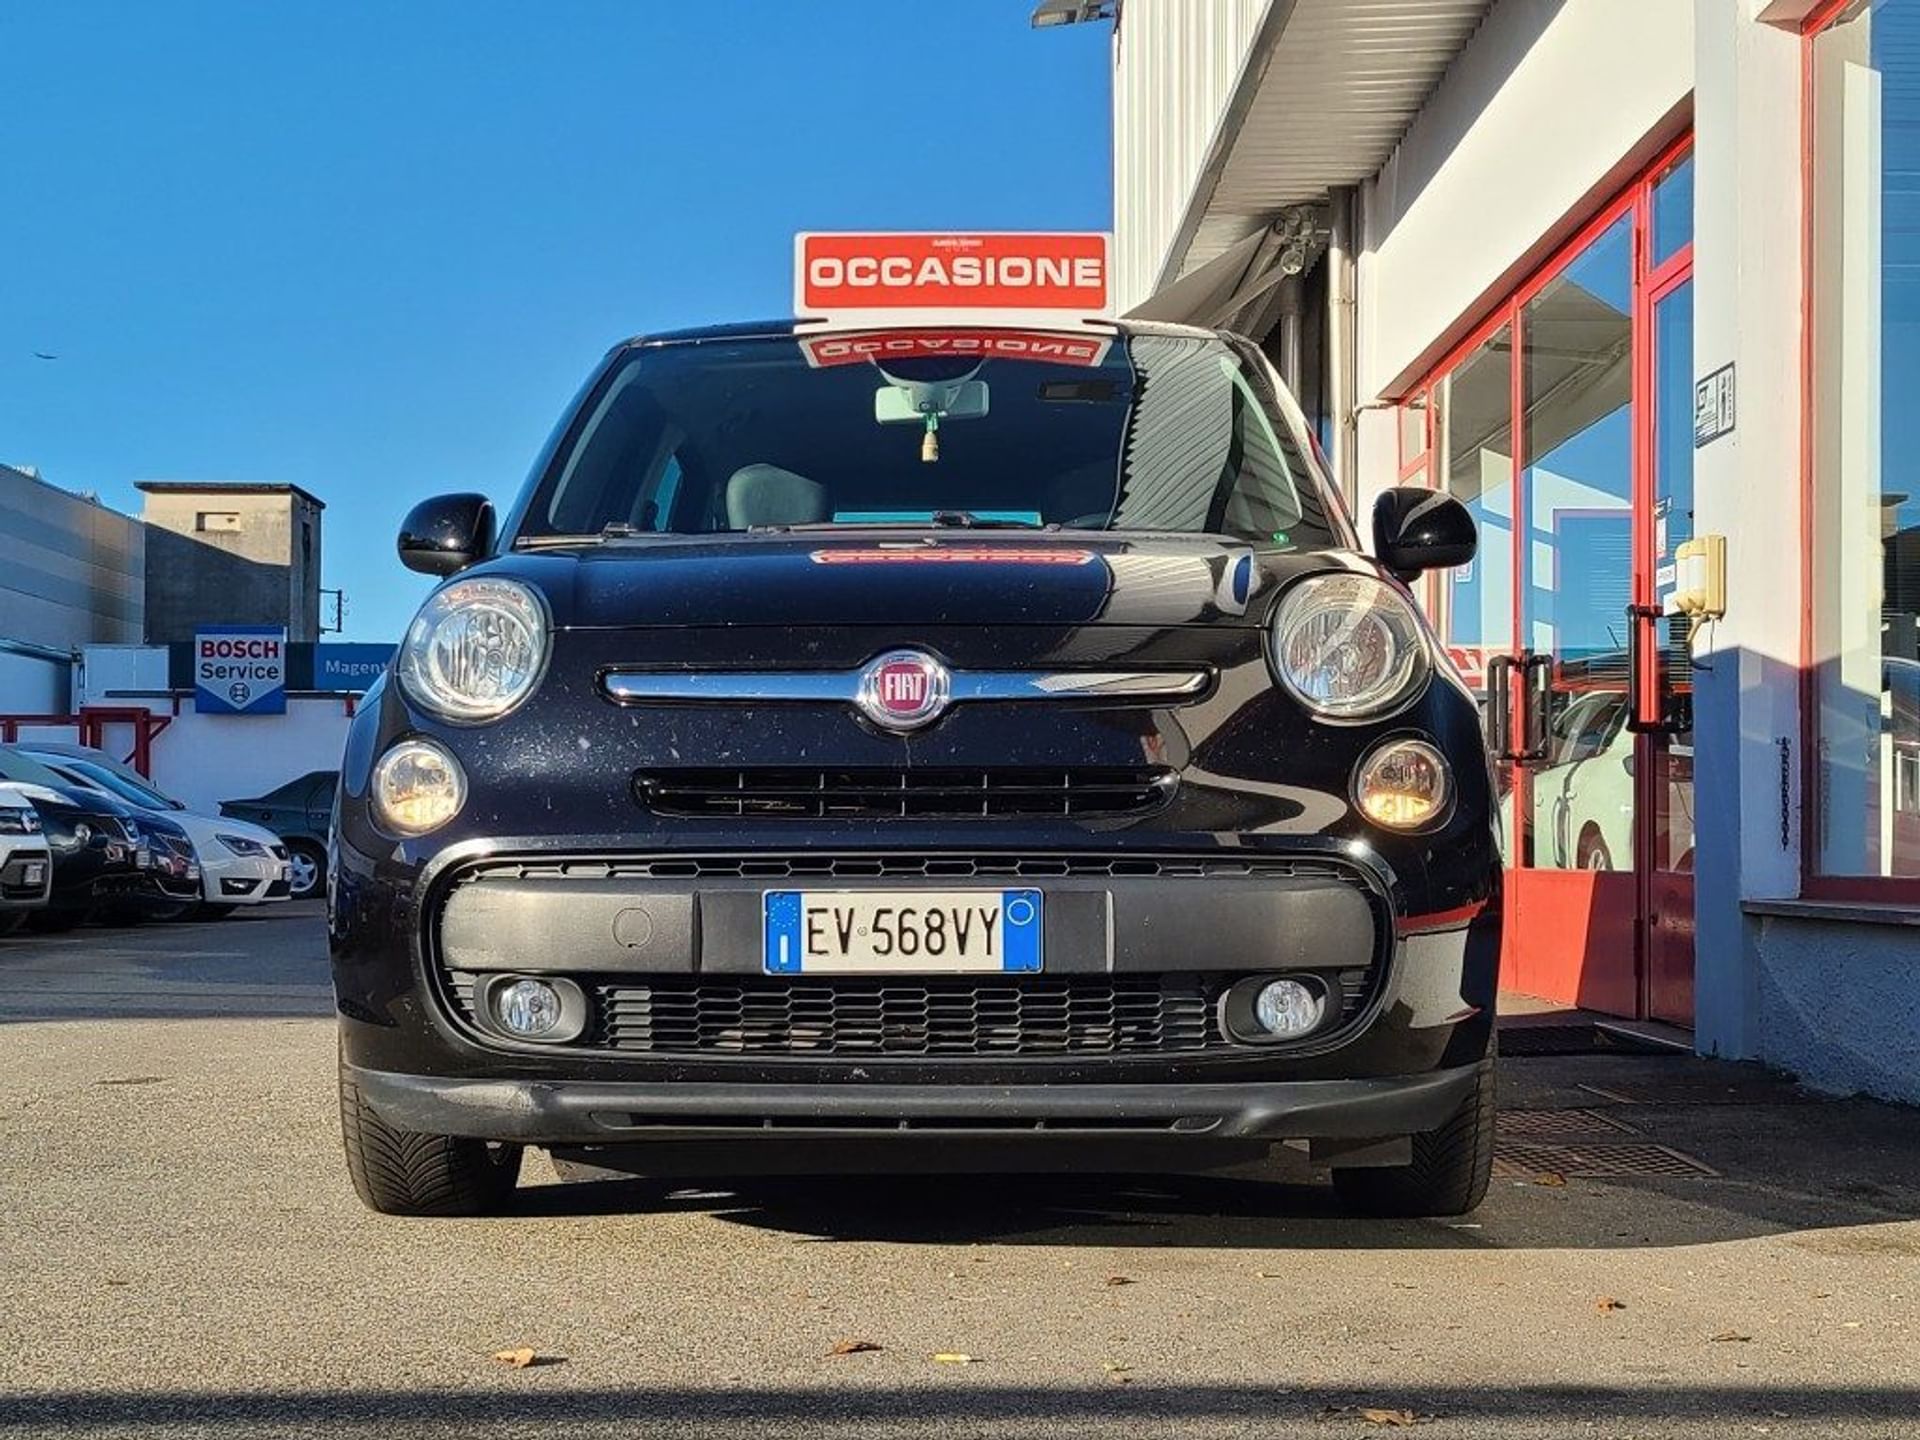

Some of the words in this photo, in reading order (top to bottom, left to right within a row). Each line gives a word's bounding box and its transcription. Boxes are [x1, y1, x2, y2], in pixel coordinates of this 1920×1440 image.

[809, 256, 1102, 287] OCCASIONE
[200, 640, 280, 659] BOSCH
[200, 662, 280, 680] Service
[884, 672, 925, 701] FIAT
[807, 907, 855, 955] EV
[871, 907, 999, 956] 568VY
